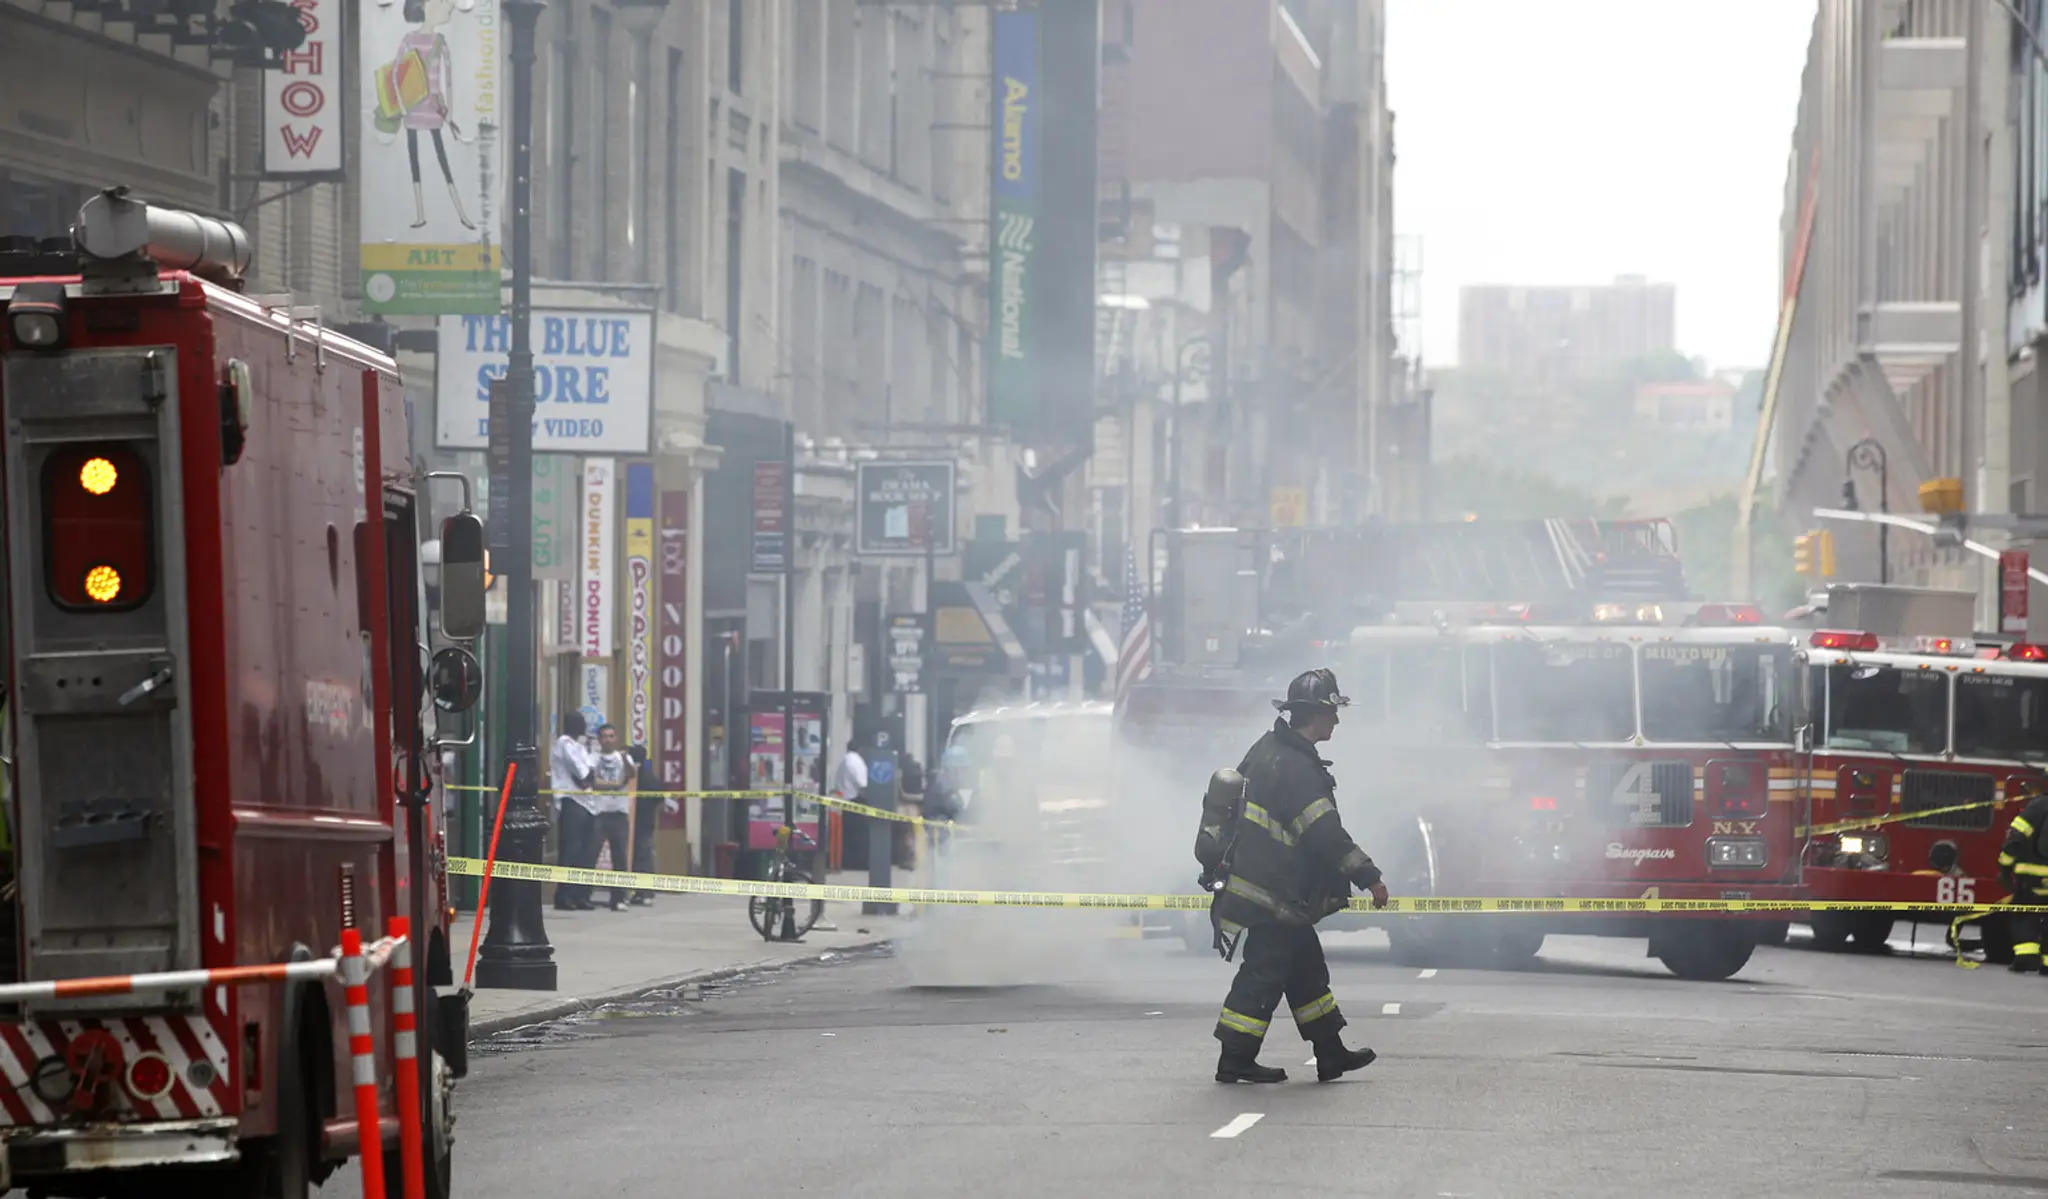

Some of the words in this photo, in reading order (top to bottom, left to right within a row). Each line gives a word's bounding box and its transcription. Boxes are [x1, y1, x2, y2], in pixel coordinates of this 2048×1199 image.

[1003, 76, 1028, 181] Alamo
[1001, 250, 1025, 360] National
[461, 314, 514, 352] TH
[543, 317, 630, 357] BLUE
[476, 363, 609, 404] SORE
[544, 418, 603, 437] VIDEO
[1612, 761, 1662, 823] 4
[1712, 821, 1762, 836] N.Y.
[1605, 842, 1676, 867] Seagrave
[1936, 876, 1976, 904] 65
